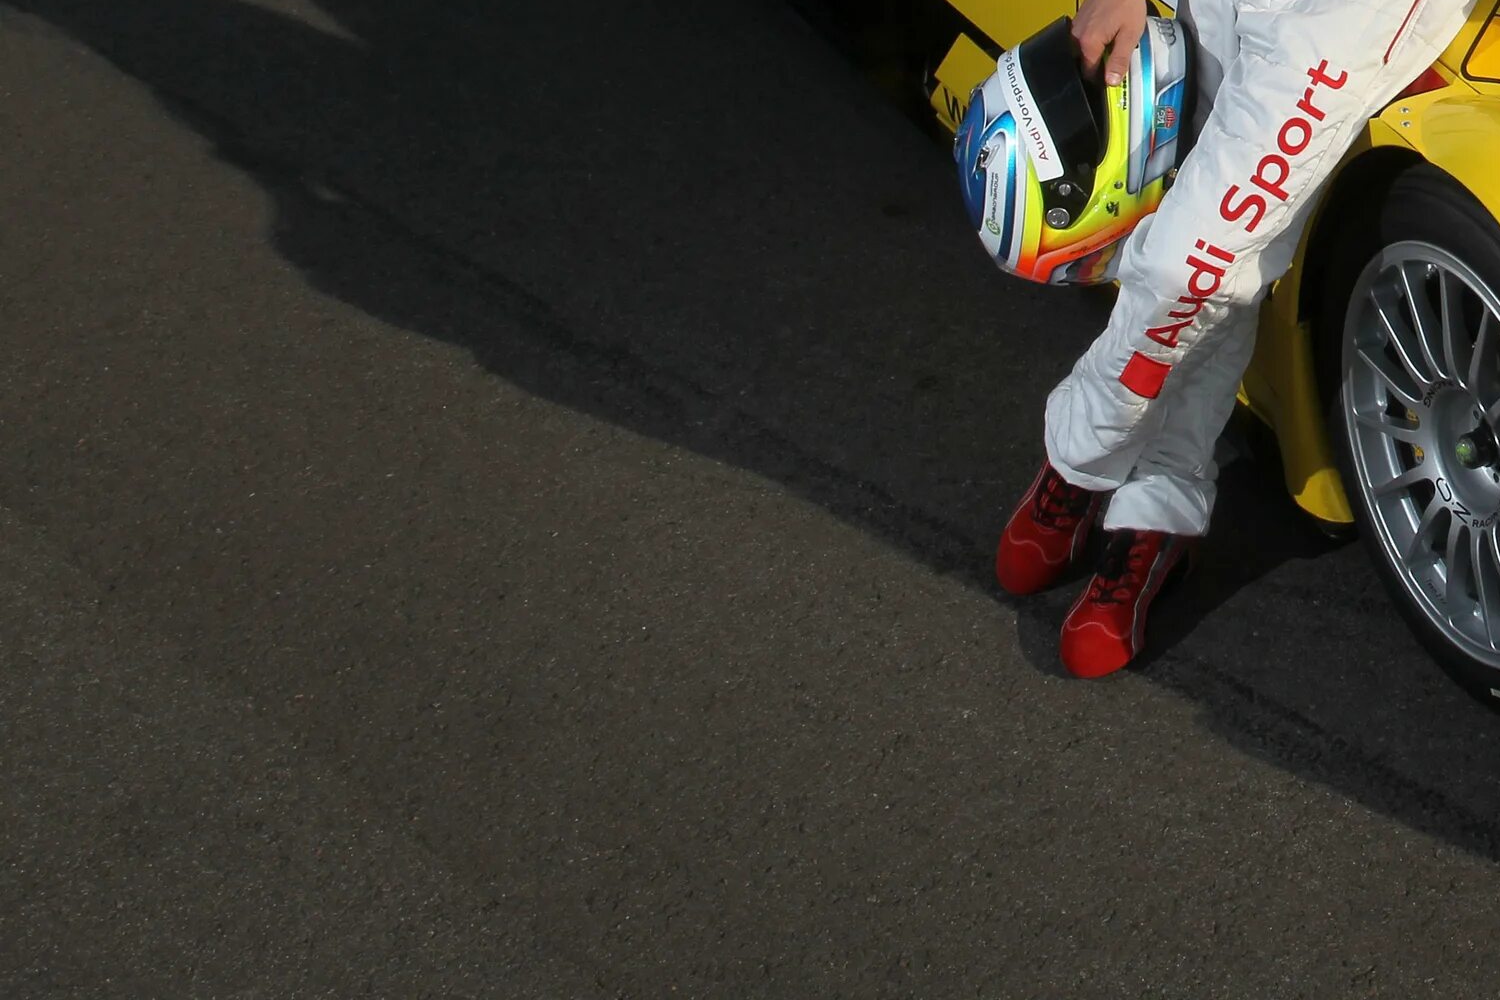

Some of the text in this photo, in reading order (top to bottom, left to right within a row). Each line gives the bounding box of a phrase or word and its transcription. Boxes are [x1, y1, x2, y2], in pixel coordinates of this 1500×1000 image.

[1006, 63, 1033, 128] Vorsprung
[1030, 126, 1049, 161] Audi
[1146, 59, 1348, 349] Audi Sport
